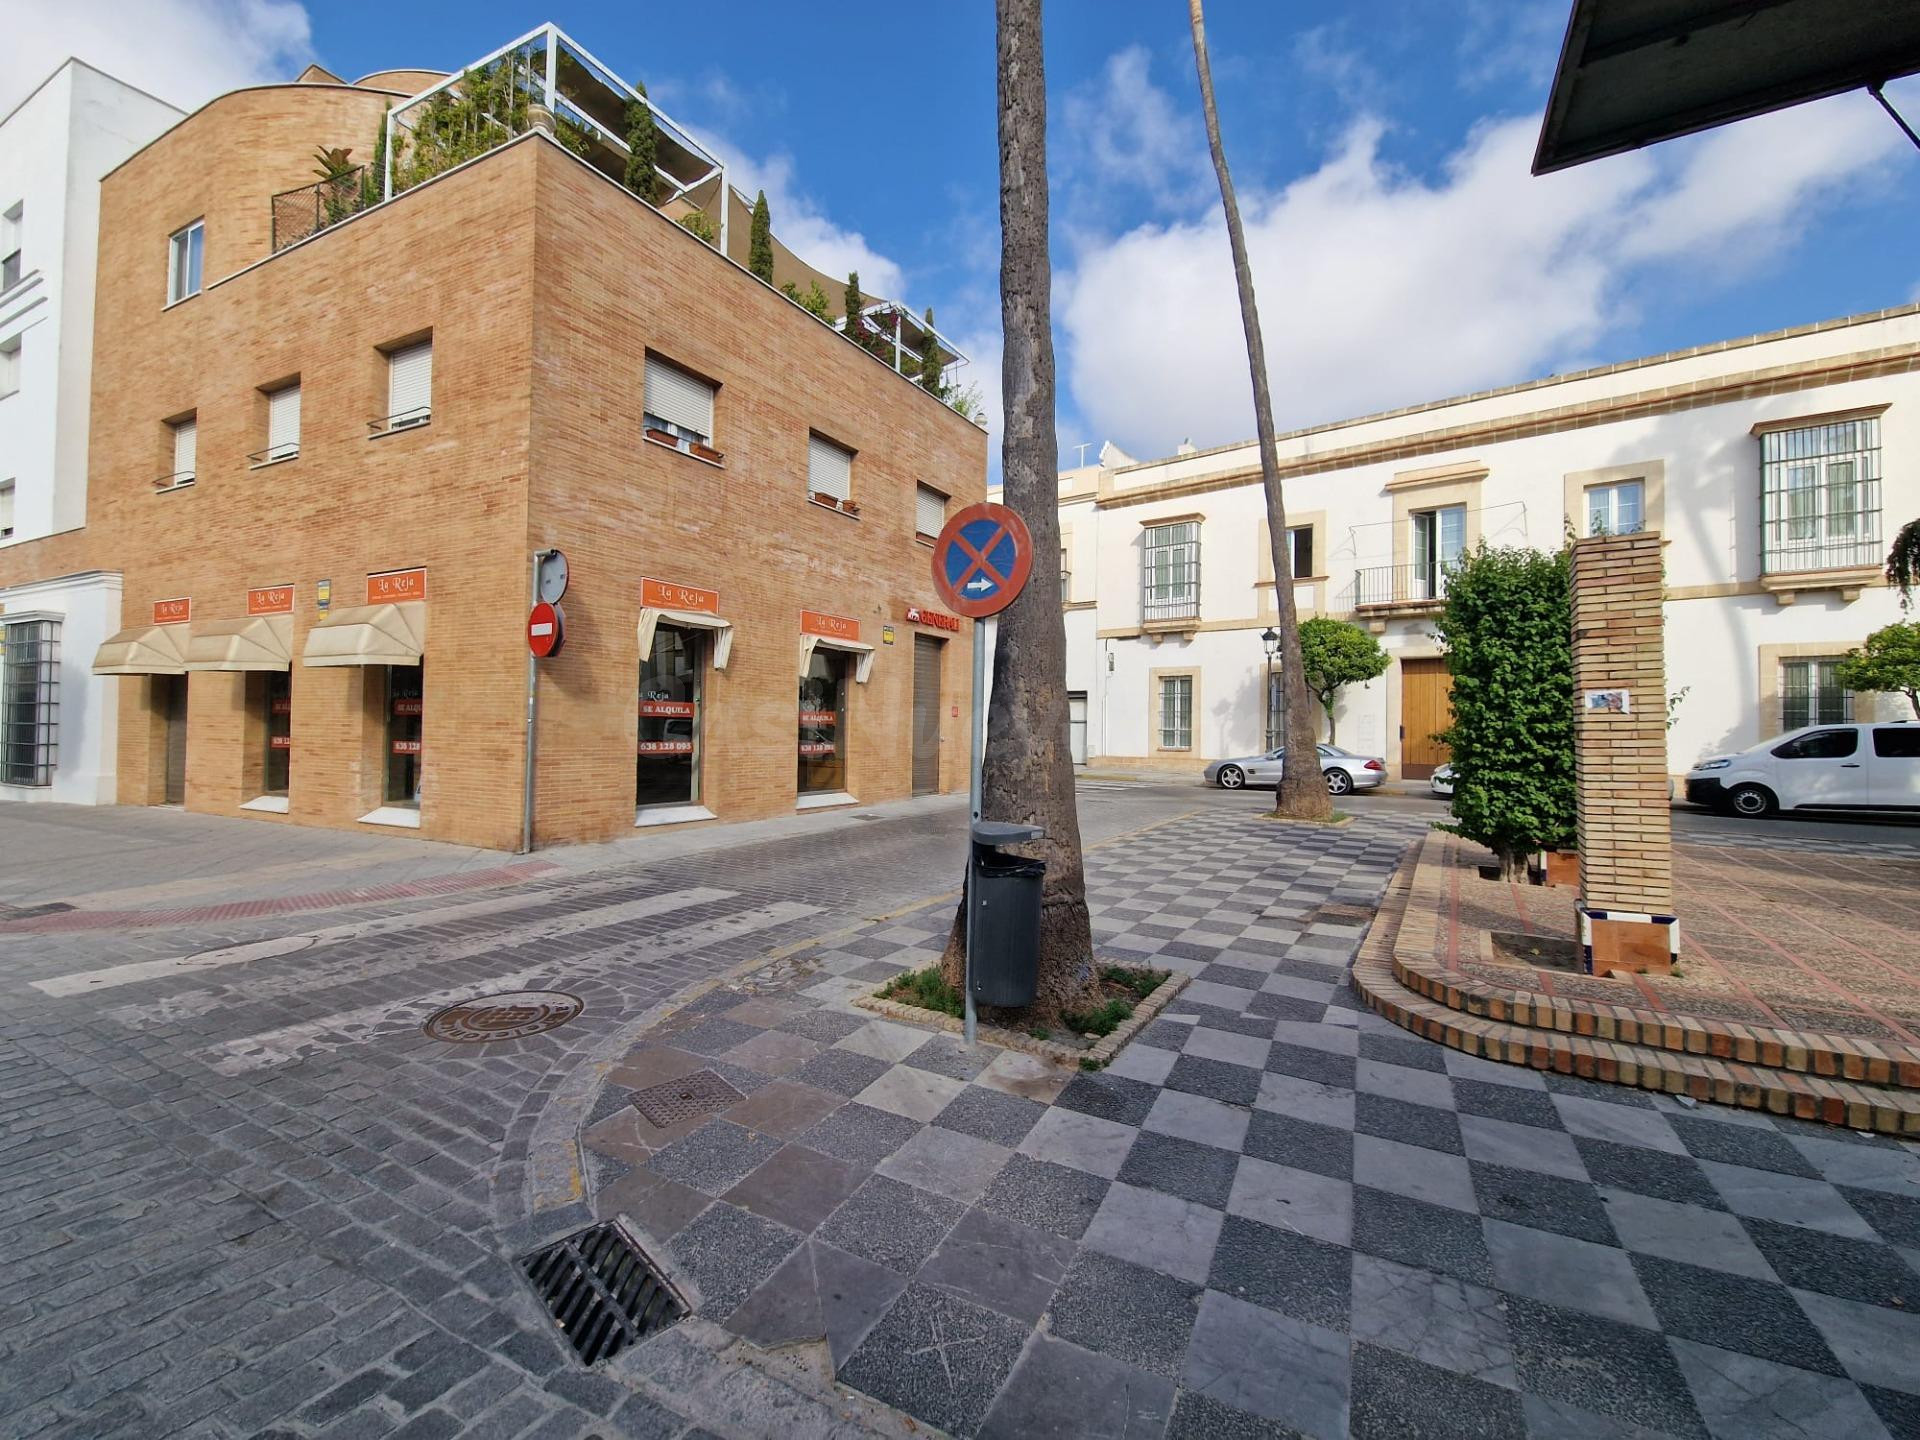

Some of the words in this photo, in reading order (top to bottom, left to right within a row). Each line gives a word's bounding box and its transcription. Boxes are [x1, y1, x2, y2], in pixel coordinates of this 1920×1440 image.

[392, 576, 415, 591] Reja
[678, 588, 704, 607] Reja
[642, 704, 653, 713] SE
[655, 705, 690, 715] ALQUILA
